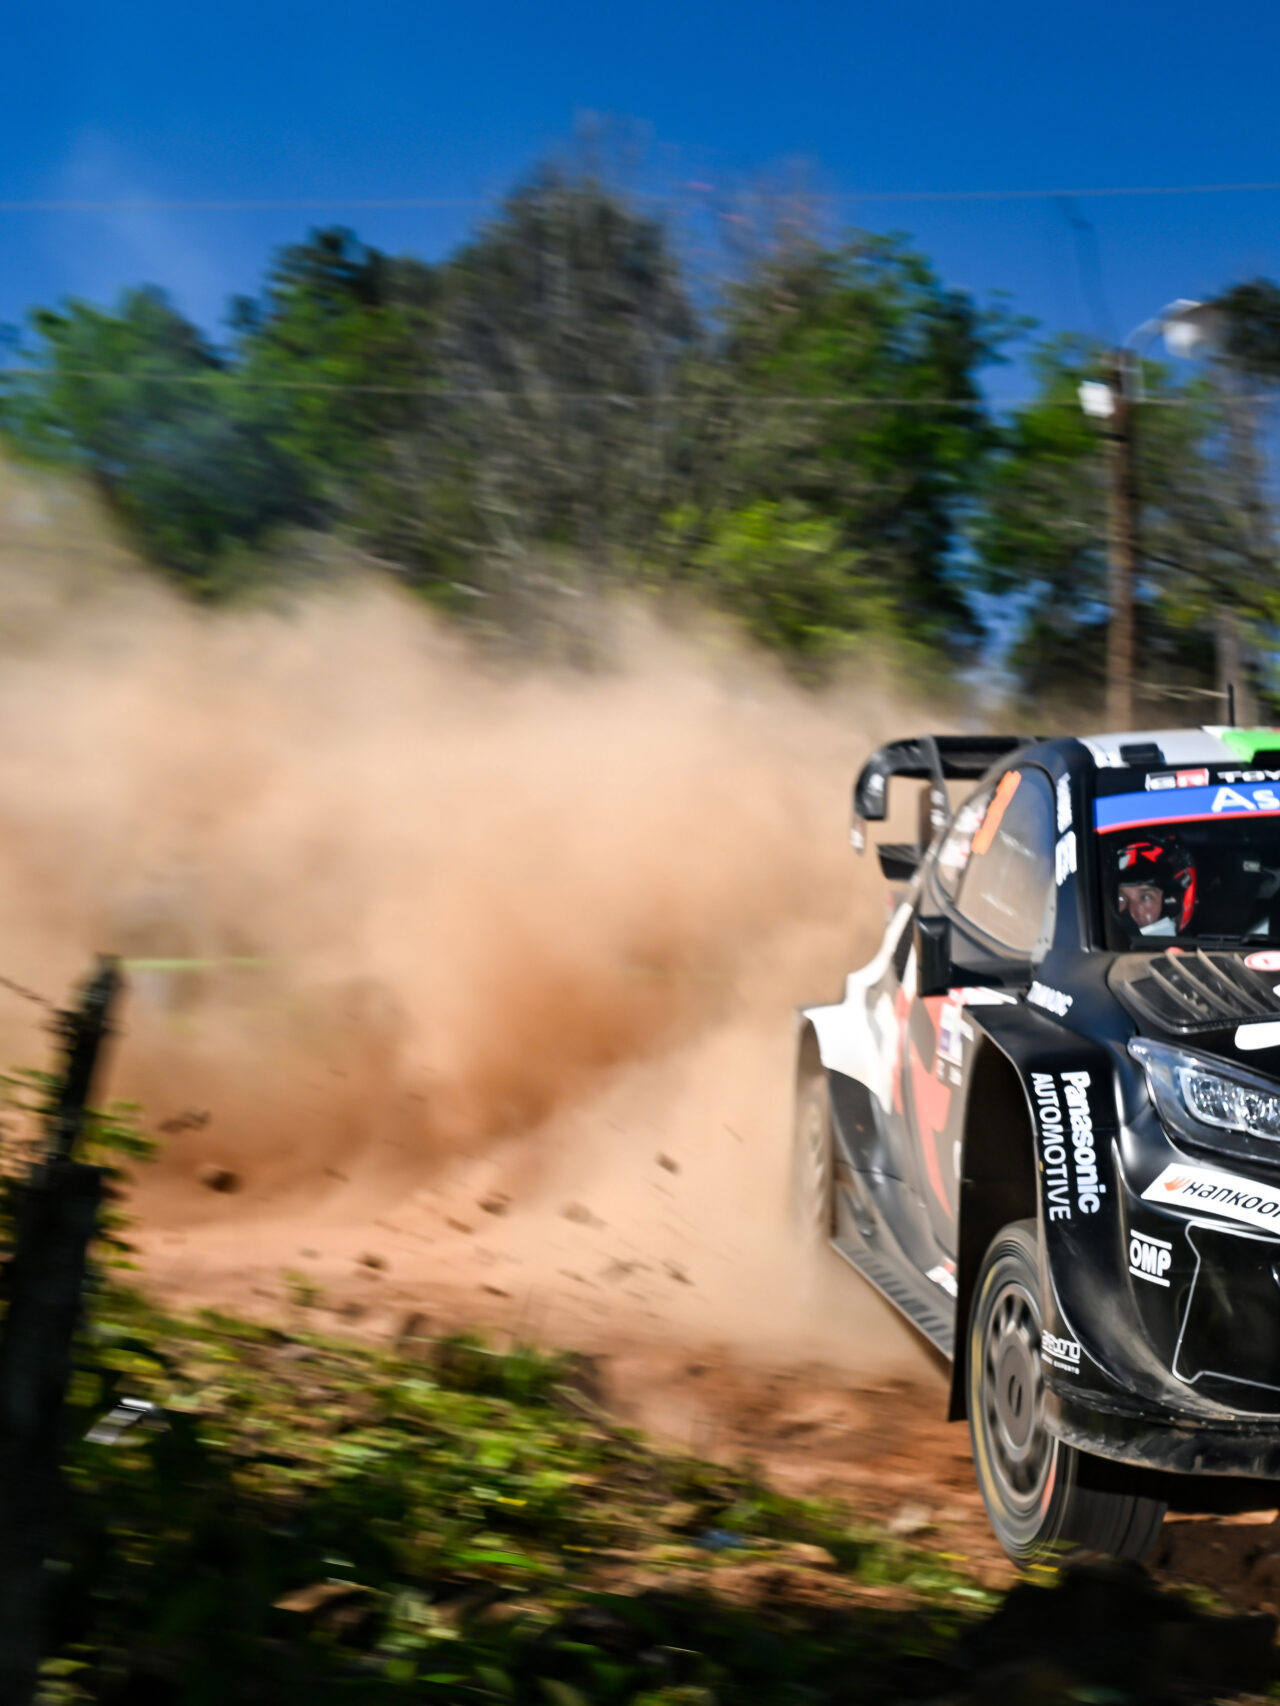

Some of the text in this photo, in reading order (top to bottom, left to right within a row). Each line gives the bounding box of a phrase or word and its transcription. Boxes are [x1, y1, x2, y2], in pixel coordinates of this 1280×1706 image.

[1031, 1072, 1072, 1221] AUTOMOTIVE
[1061, 1070, 1106, 1215] Panasonic
[1129, 1237, 1172, 1278] OMP
